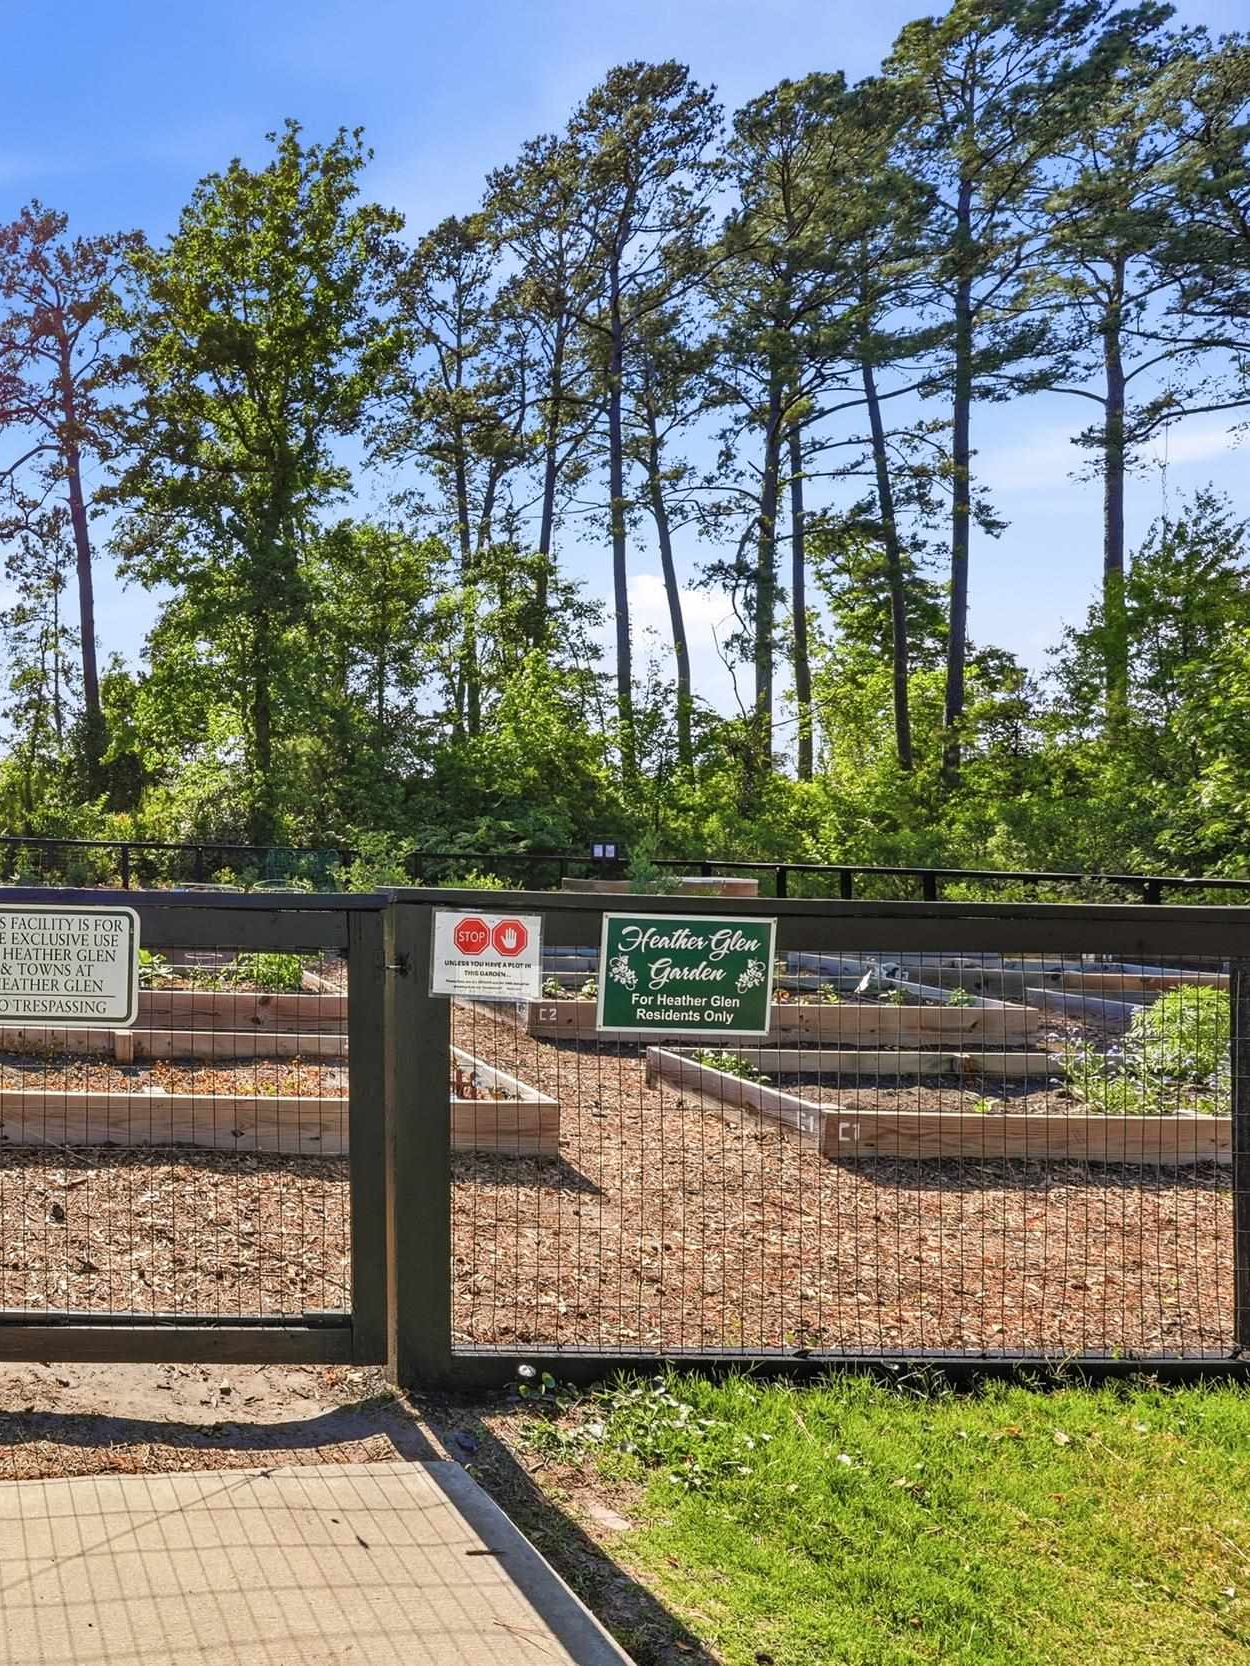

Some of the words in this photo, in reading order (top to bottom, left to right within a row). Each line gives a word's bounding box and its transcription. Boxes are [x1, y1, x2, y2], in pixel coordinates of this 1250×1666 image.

[11, 917, 75, 931] FACILITY
[78, 919, 89, 931] IS
[94, 919, 123, 932] FOR
[11, 932, 89, 946] EXCLUSIVE
[94, 934, 119, 947] USE
[458, 931, 485, 942] STOP
[618, 925, 708, 952] Heather
[709, 929, 761, 961] Glen
[3, 947, 72, 961] HEATHER
[76, 949, 116, 962] GLEN
[0, 963, 13, 975] &
[17, 963, 71, 976] TOWNS
[75, 964, 94, 977] AT
[648, 957, 726, 990] Garden
[64, 979, 104, 992] GLEN
[13, 999, 107, 1014] TRESPASSING
[631, 993, 654, 1005] For
[657, 994, 706, 1007] Heather
[710, 995, 740, 1007] Glen
[636, 1008, 700, 1021] Residents
[704, 1010, 734, 1025] Only
